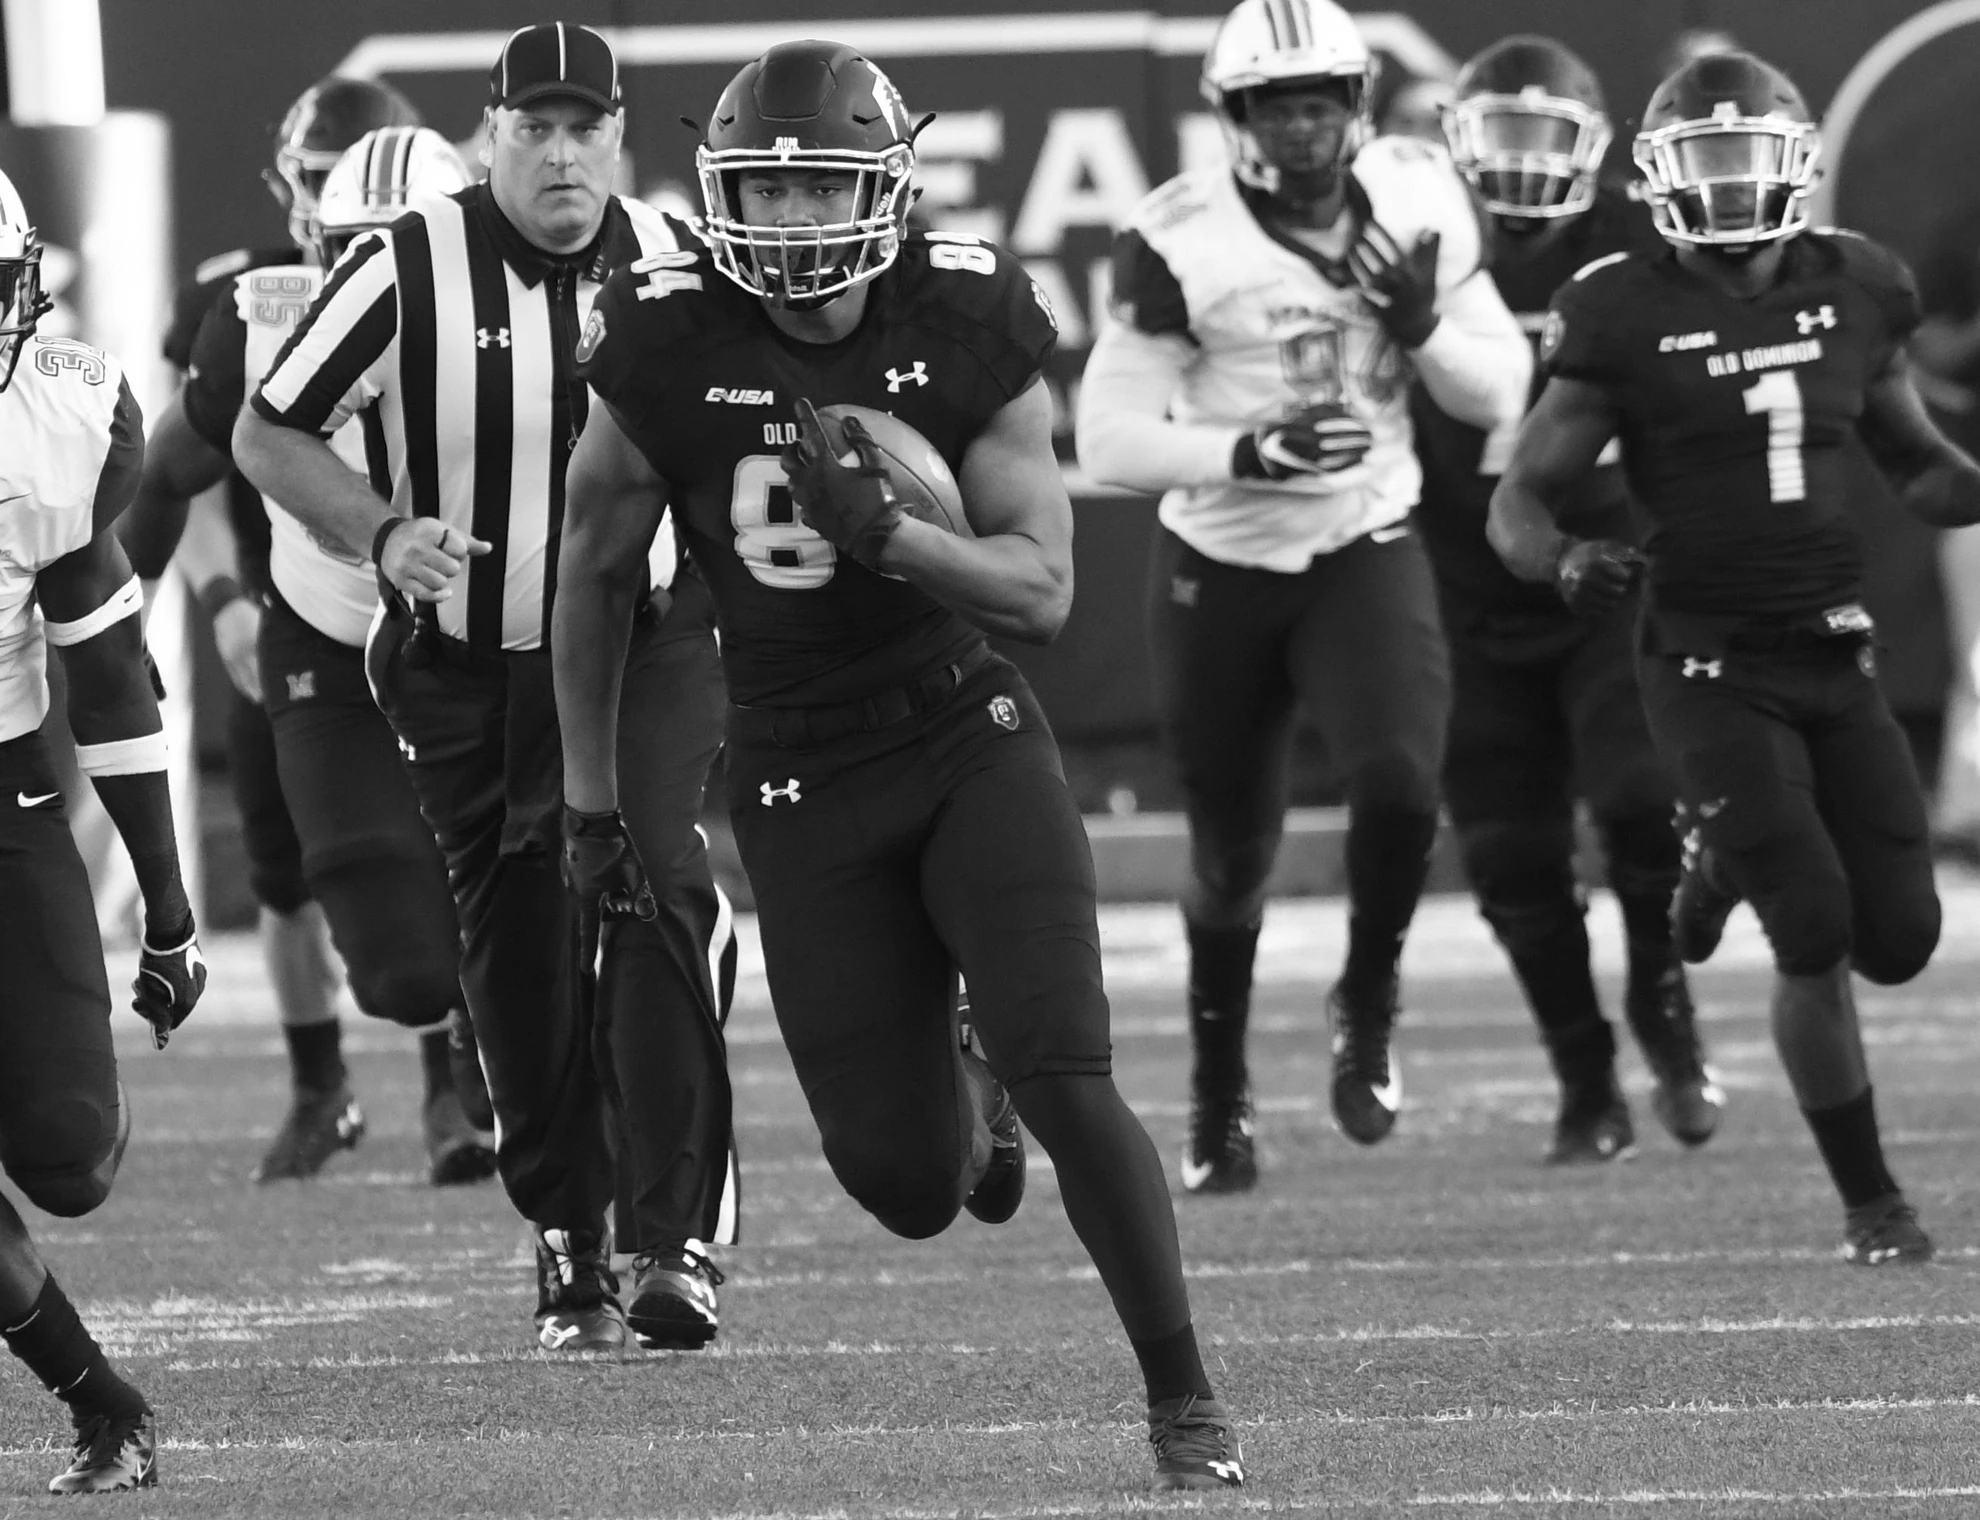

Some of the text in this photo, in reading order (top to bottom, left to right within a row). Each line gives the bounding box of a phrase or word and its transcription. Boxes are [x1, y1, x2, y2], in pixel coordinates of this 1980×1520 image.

[1706, 338, 1823, 378] OLD DOMINION
[763, 422, 798, 445] OLD
[1742, 370, 1806, 503] 1
[731, 454, 837, 589] 8
